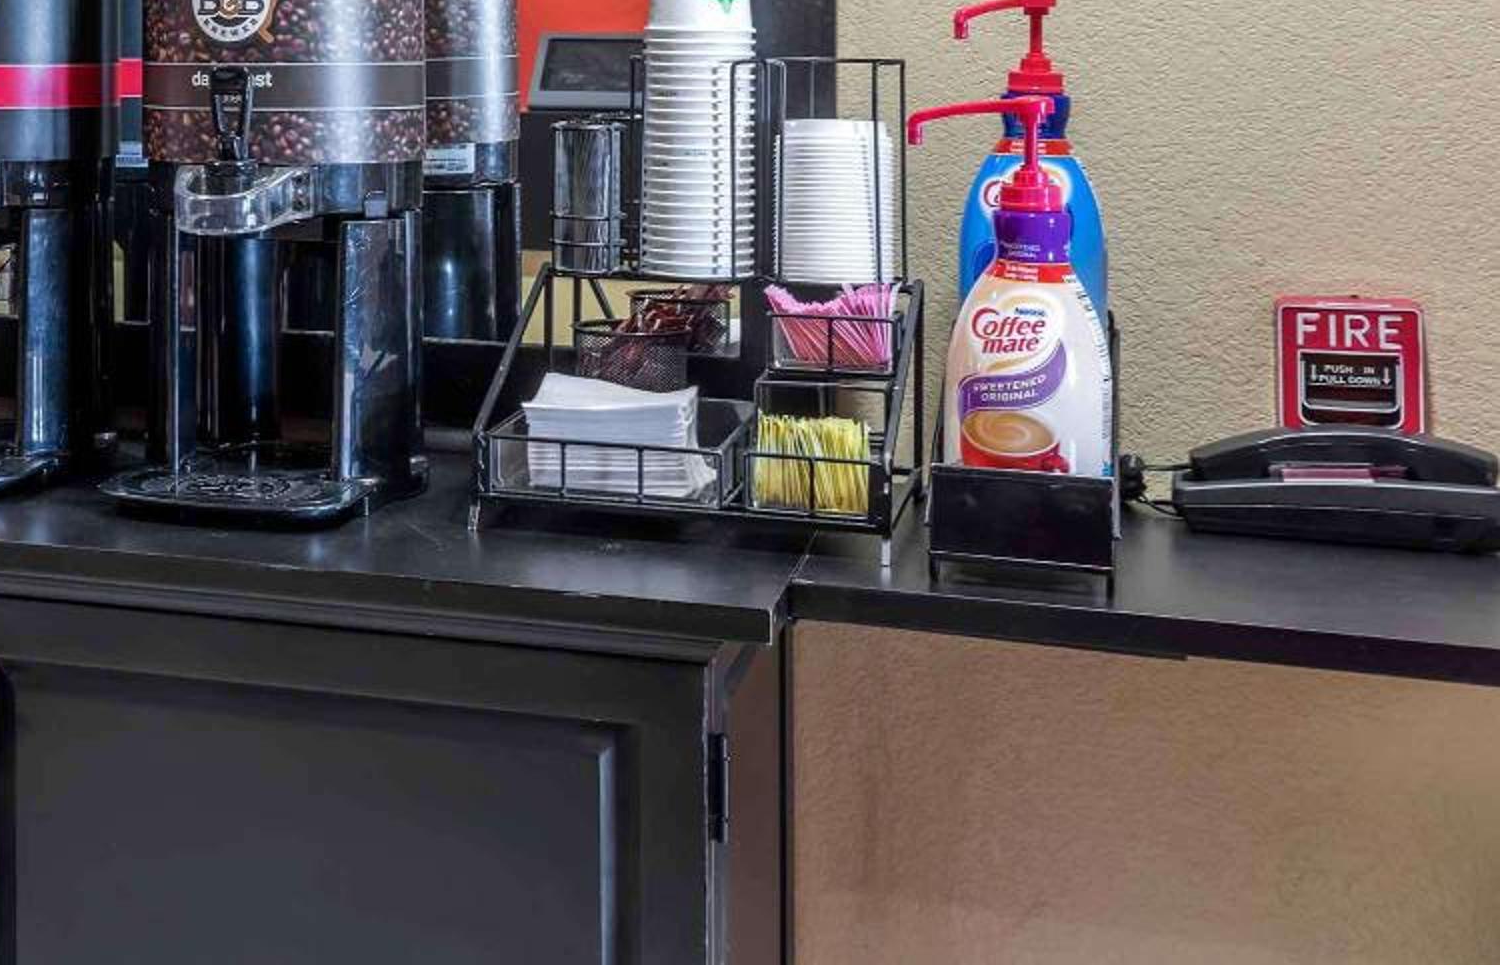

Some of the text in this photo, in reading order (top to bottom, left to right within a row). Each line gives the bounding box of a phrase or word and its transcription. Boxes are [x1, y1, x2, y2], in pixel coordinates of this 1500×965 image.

[971, 306, 1046, 340] Coffee
[1296, 312, 1403, 350] FIRE
[982, 336, 1039, 354] mate
[1323, 364, 1375, 375] PUSH IN
[973, 374, 1046, 392] SWEETENED
[1319, 374, 1381, 385] PULL DOWN
[980, 389, 1038, 402] ORIGINAL
